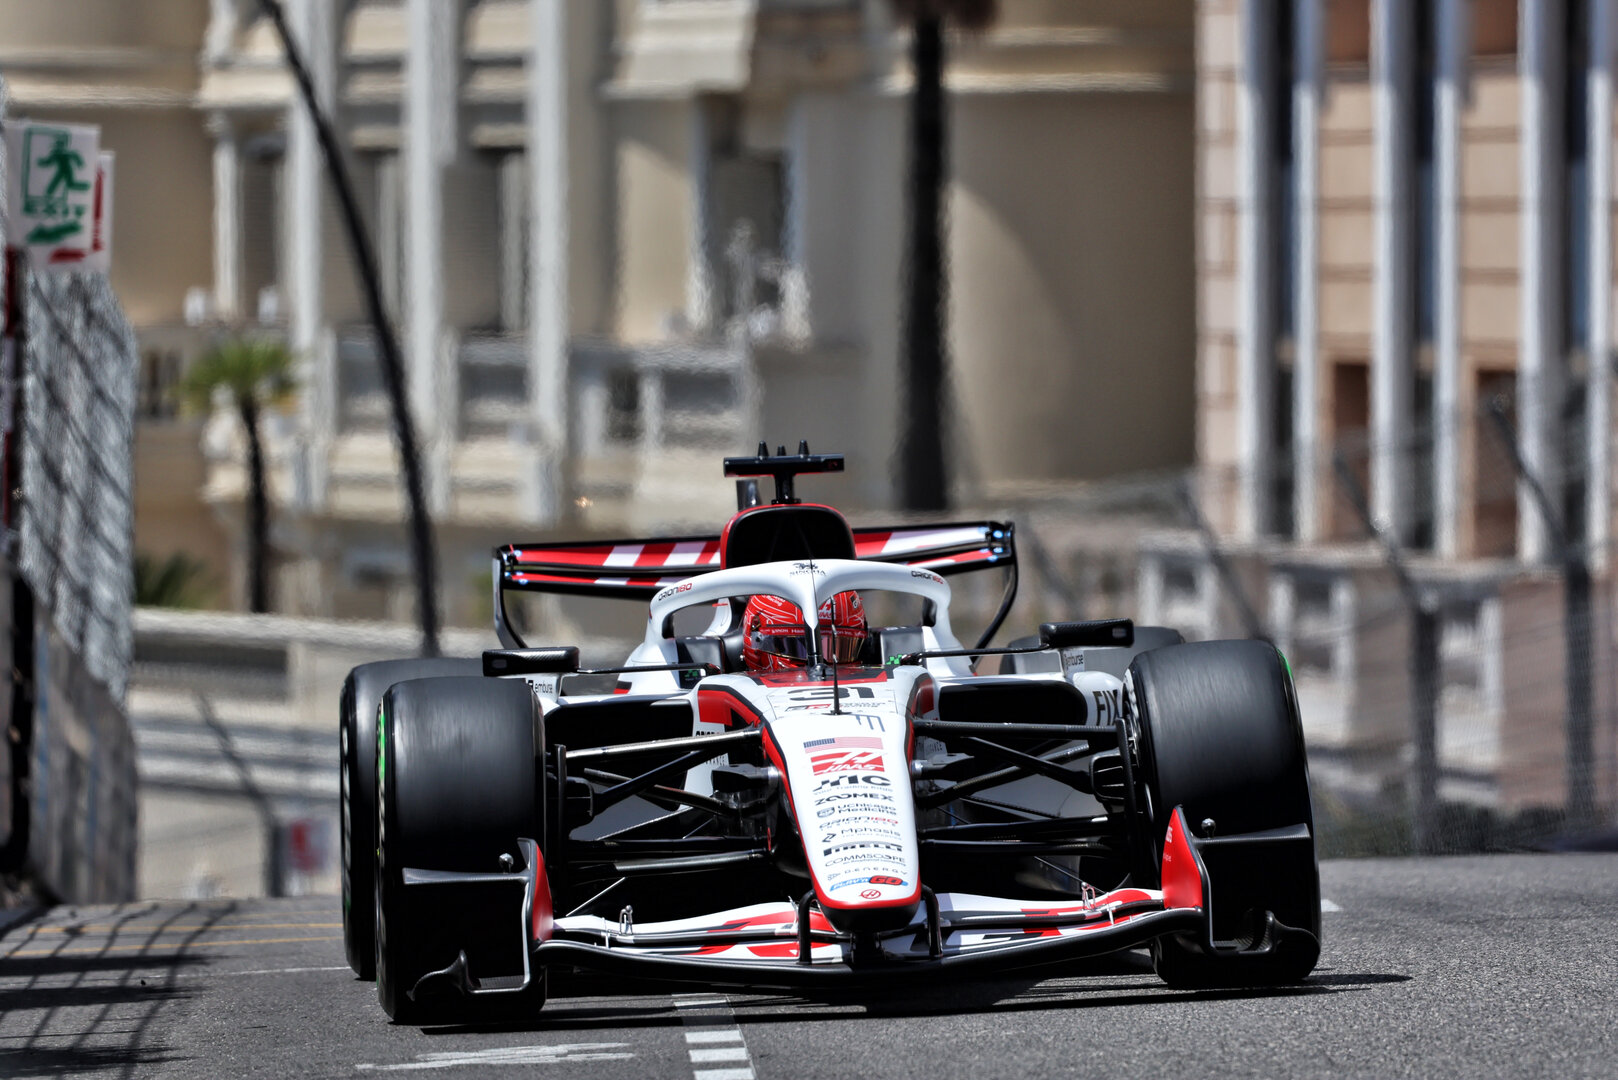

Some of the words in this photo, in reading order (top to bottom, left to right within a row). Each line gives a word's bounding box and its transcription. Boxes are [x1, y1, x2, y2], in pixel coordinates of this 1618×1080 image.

[787, 686, 875, 701] 31
[814, 793, 895, 806] ZOOMEX
[838, 807, 897, 816] Medicine
[841, 827, 901, 837] Mphasis
[825, 853, 906, 867] COMMSCOPE
[869, 875, 903, 886] GO
